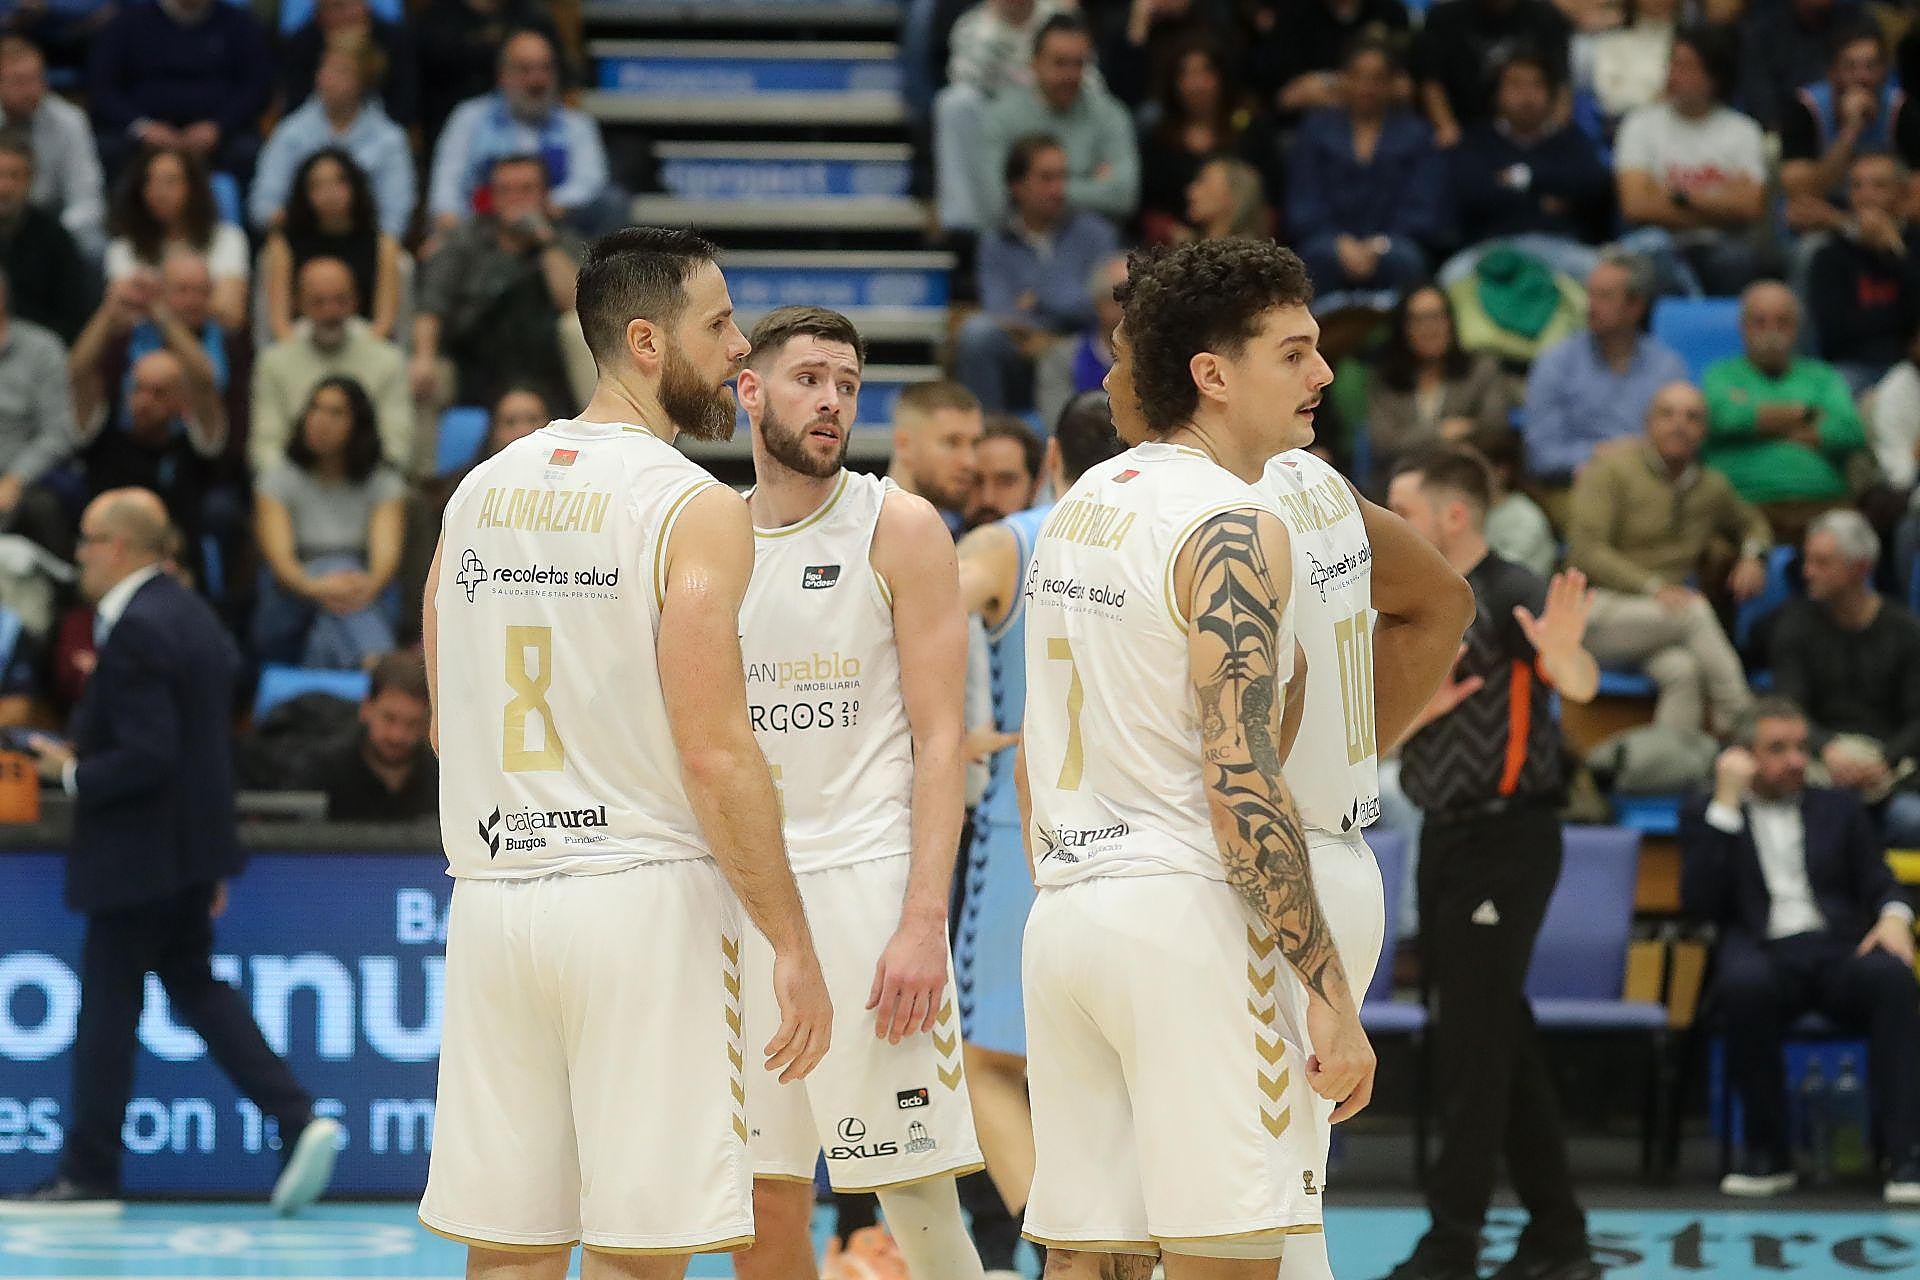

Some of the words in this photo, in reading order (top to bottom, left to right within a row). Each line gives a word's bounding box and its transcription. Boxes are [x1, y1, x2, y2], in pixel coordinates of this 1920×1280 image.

[477, 482, 612, 534] ALMAZÁN
[493, 564, 568, 585] recoletas
[575, 566, 619, 587] salud
[1089, 584, 1126, 608] salud
[747, 651, 861, 690] ANpablo
[502, 626, 565, 773] 8
[794, 681, 861, 692] INMOBILIARIA
[749, 701, 835, 734] RGOS
[1046, 637, 1085, 792] 7
[505, 805, 608, 835] cajarural
[505, 836, 547, 851] Burgos
[899, 1096, 924, 1108] acb
[828, 1141, 898, 1160] LEXUS
